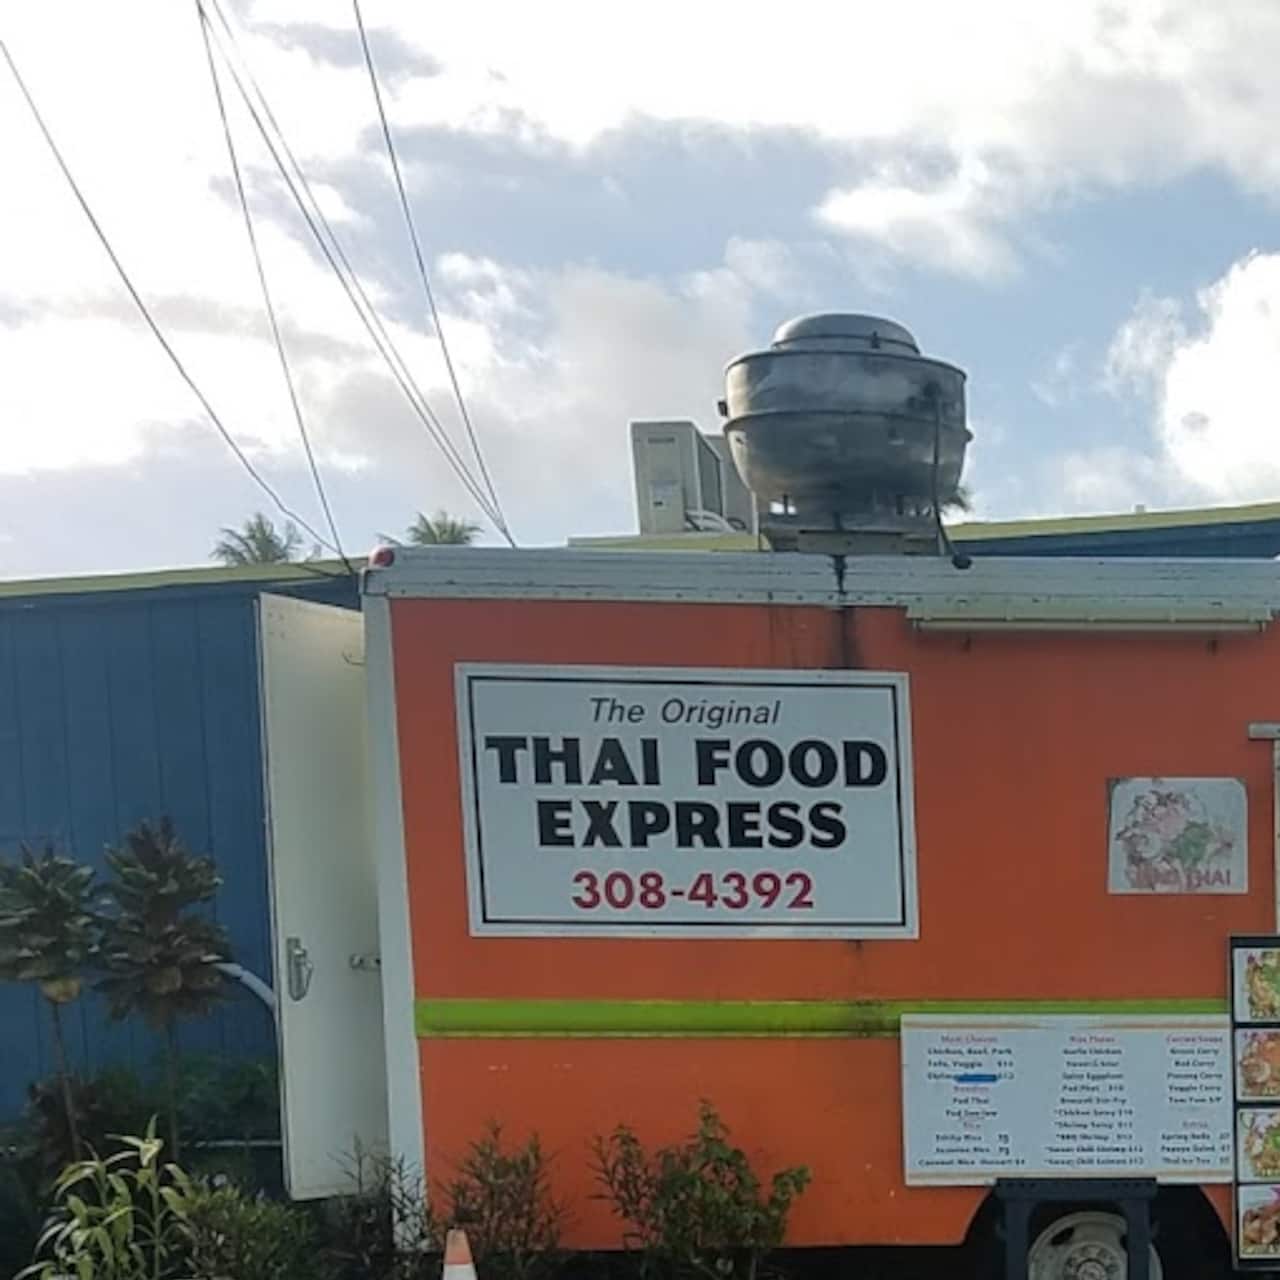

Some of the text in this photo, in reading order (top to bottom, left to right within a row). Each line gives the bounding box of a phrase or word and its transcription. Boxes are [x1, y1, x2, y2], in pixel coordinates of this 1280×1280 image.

[590, 698, 781, 729] The Original
[485, 736, 887, 788] THAI FOOD
[536, 800, 848, 849] EXPRESS
[572, 871, 814, 910] 308-4392
